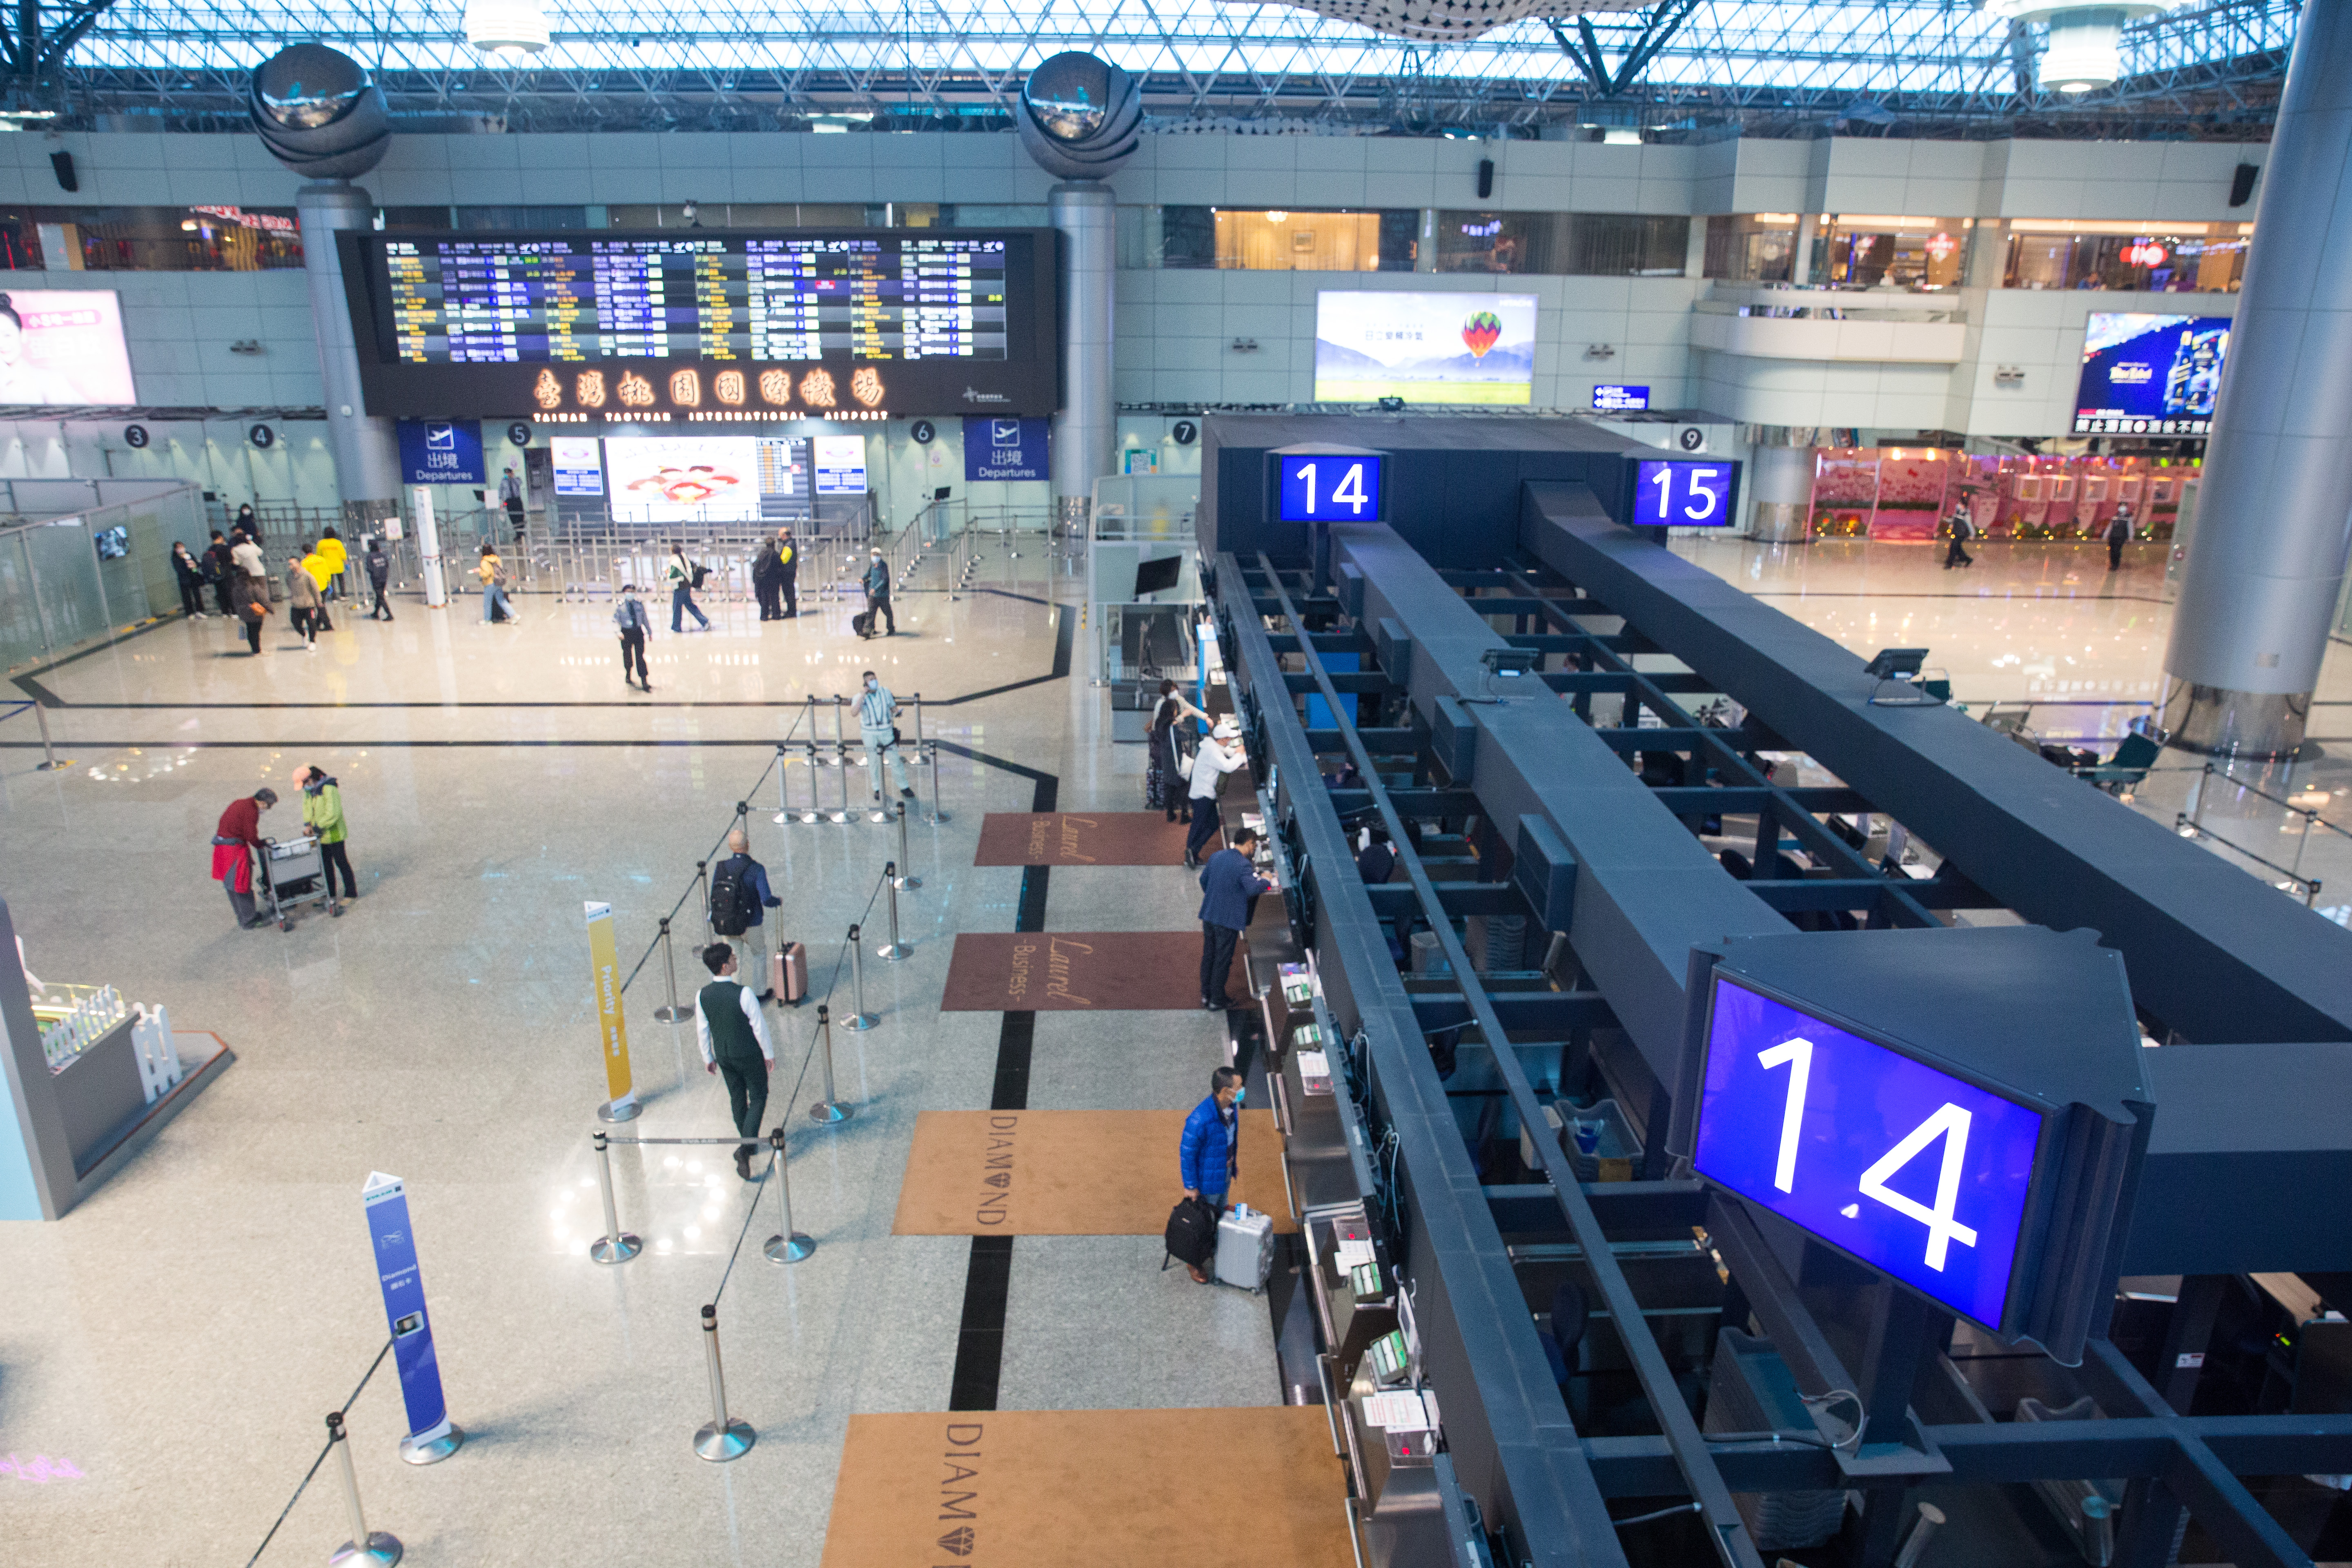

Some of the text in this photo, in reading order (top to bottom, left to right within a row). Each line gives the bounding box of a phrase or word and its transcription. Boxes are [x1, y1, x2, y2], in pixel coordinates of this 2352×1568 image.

[533, 411, 889, 423] TAIWAN TAOYUAN INTERNATIONAL AIRPORT
[134, 430, 143, 445] 3
[256, 429, 267, 443] 4
[514, 428, 526, 443] 5
[918, 425, 928, 441] 6
[1180, 424, 1190, 441] 7
[1687, 432, 1696, 445] 9
[427, 453, 459, 470] 出境
[991, 450, 1023, 466] 出境
[416, 470, 473, 483] Departures
[978, 466, 1036, 479] Departures
[1296, 463, 1368, 514] 14
[1652, 468, 1718, 520] 15
[600, 964, 615, 1015] Priority
[1757, 1037, 1977, 1273] 14
[381, 1263, 417, 1282] Diamond
